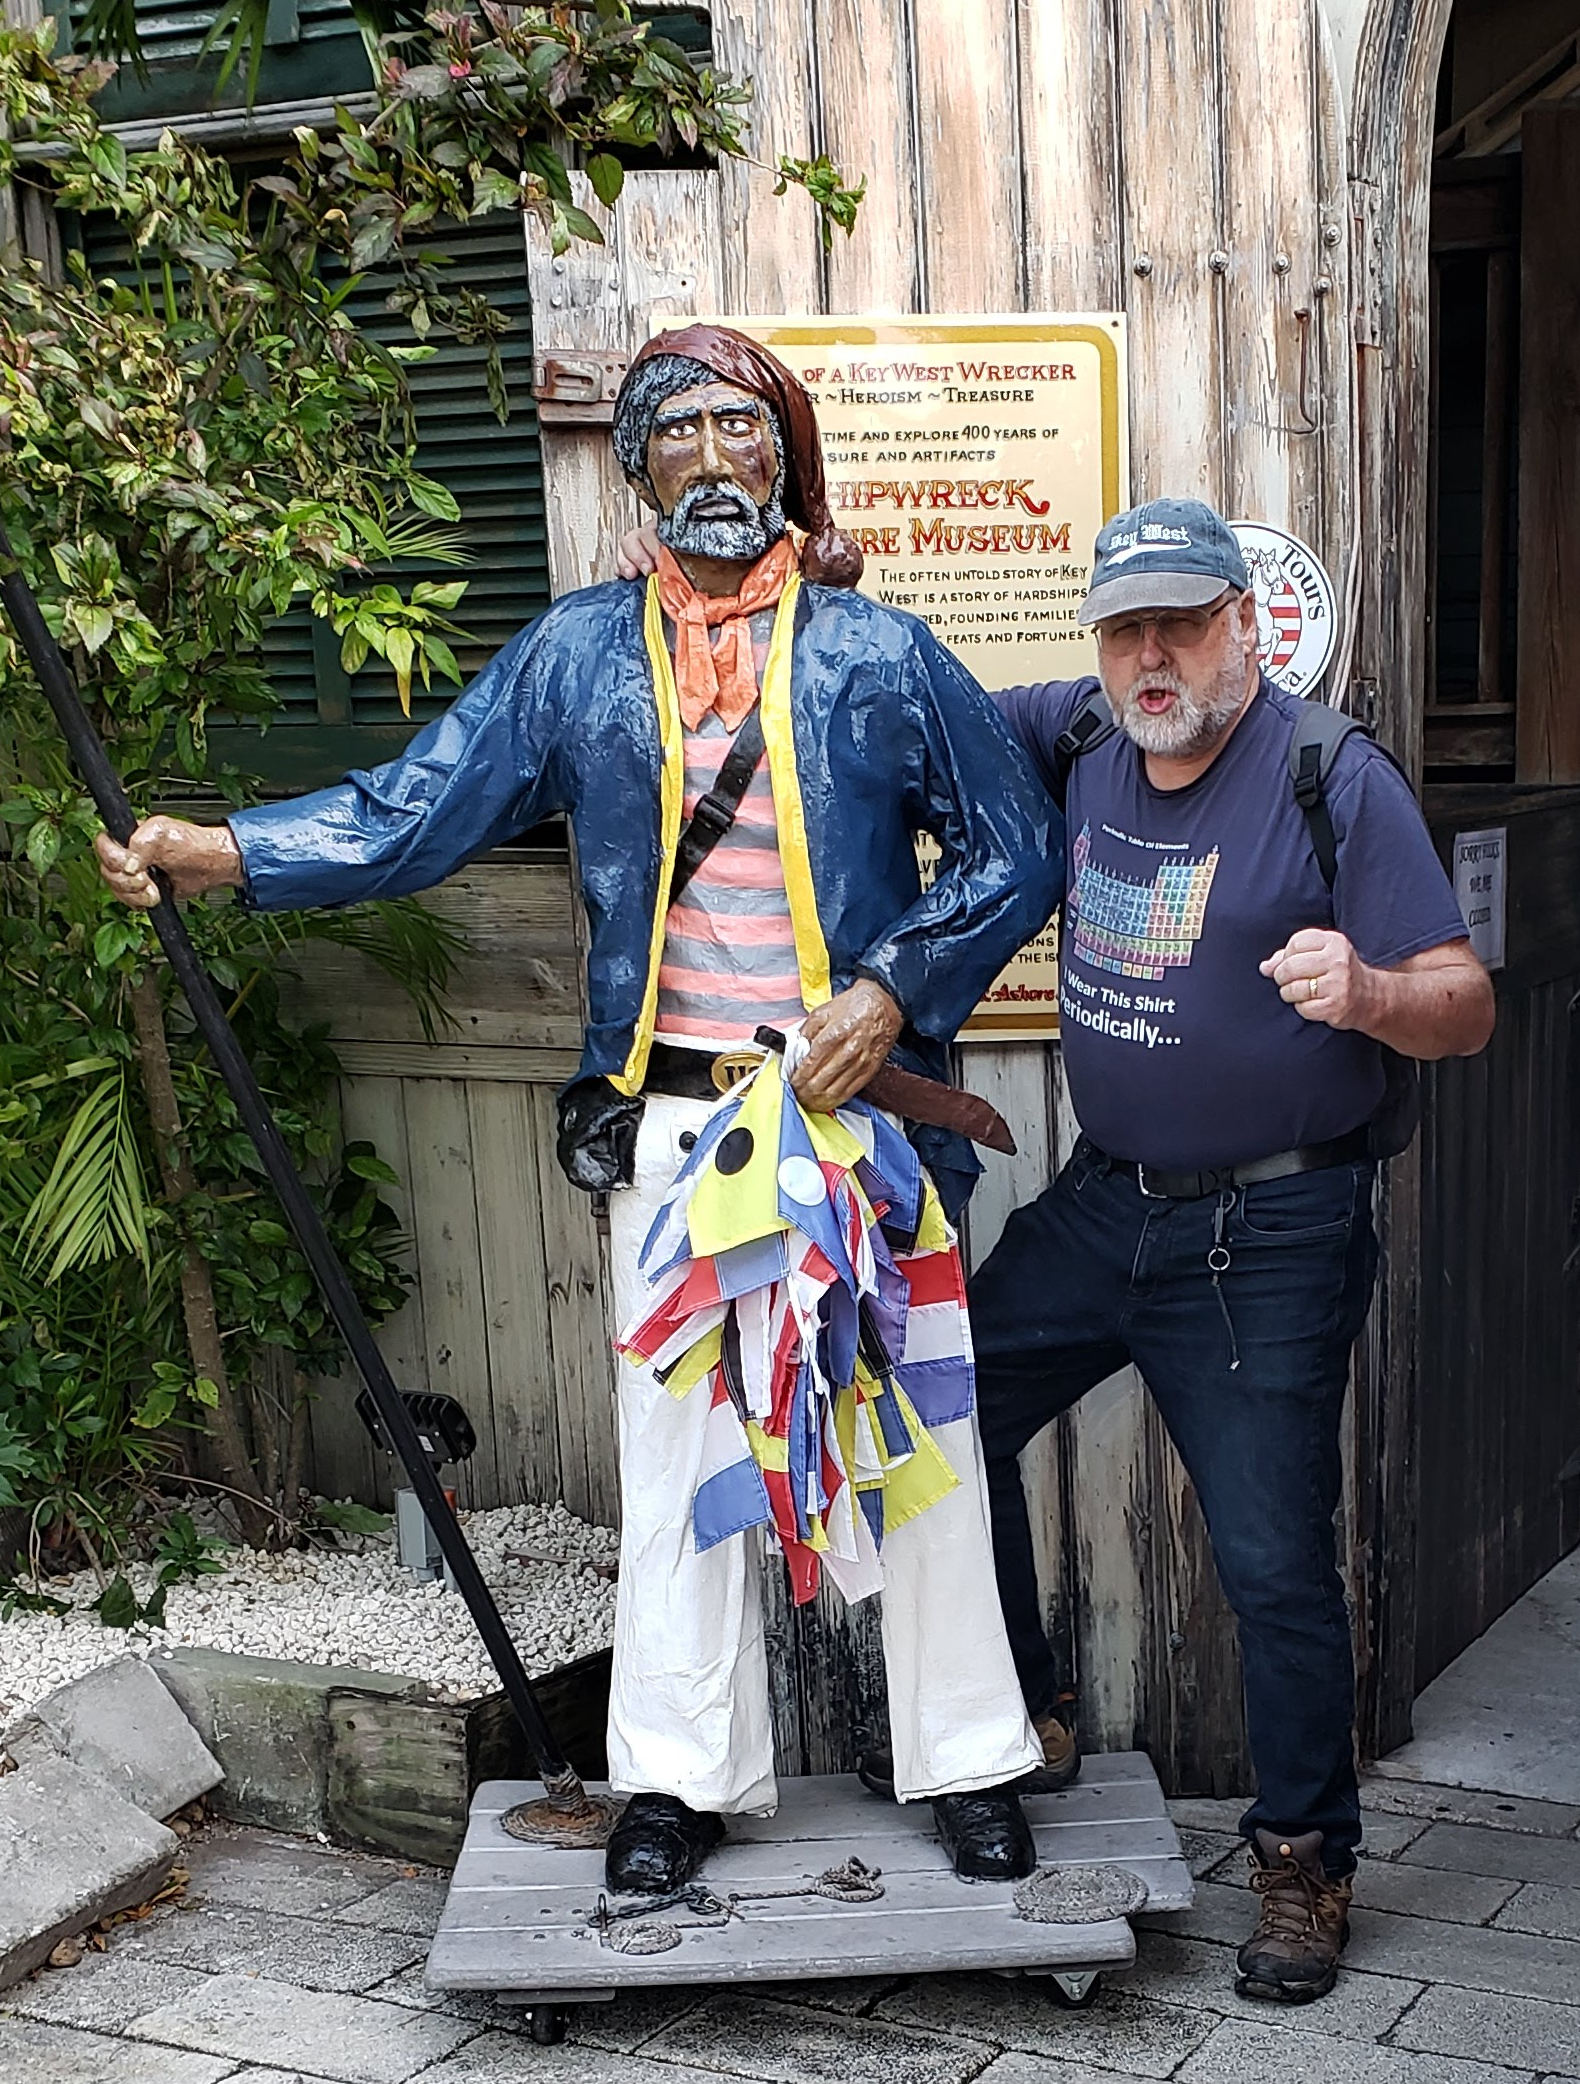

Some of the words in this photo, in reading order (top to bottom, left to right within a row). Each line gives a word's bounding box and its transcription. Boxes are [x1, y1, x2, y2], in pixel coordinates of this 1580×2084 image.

[803, 367, 825, 383] OF
[829, 367, 845, 383] A
[847, 362, 890, 384] KEY
[890, 362, 954, 383] WEST
[956, 361, 1076, 383] WRECKER
[838, 388, 922, 405] HEROISM
[942, 387, 1034, 403] TREASURE
[822, 431, 857, 443] TIME
[860, 431, 890, 443] AND
[895, 430, 960, 442] EXPLORE
[962, 424, 991, 440] 400
[993, 428, 1037, 441] YEARS
[1042, 428, 1059, 440] OF
[825, 451, 869, 464] SURE
[876, 450, 907, 464] AND
[912, 449, 996, 463] ARTIFACTS
[825, 479, 1050, 518] HIPWRECK
[908, 517, 1072, 556] MUSEUM
[1108, 531, 1139, 551] Key
[1140, 523, 1188, 541] West
[879, 568, 906, 583] THE
[909, 571, 950, 583] OFTEN
[954, 569, 1000, 581] UNTOLD
[1002, 568, 1041, 580] STORY
[1044, 567, 1059, 579] OF
[1060, 564, 1088, 581] KEY
[1279, 543, 1326, 621] Tours
[877, 590, 918, 606] WEST
[924, 592, 936, 604] IS
[939, 593, 949, 605] A
[950, 591, 990, 602] STORY
[993, 591, 1010, 602] OF
[1014, 587, 1088, 602] HARDSHIPS
[949, 611, 1019, 625] FOUNDING
[946, 633, 981, 645] FEATS
[985, 632, 1013, 644] AND
[1016, 630, 1085, 644] FORTUNES
[1017, 953, 1042, 964] THE
[1068, 969, 1098, 998] Wear
[1100, 986, 1132, 1009] This
[1133, 995, 1176, 1013] Shirt
